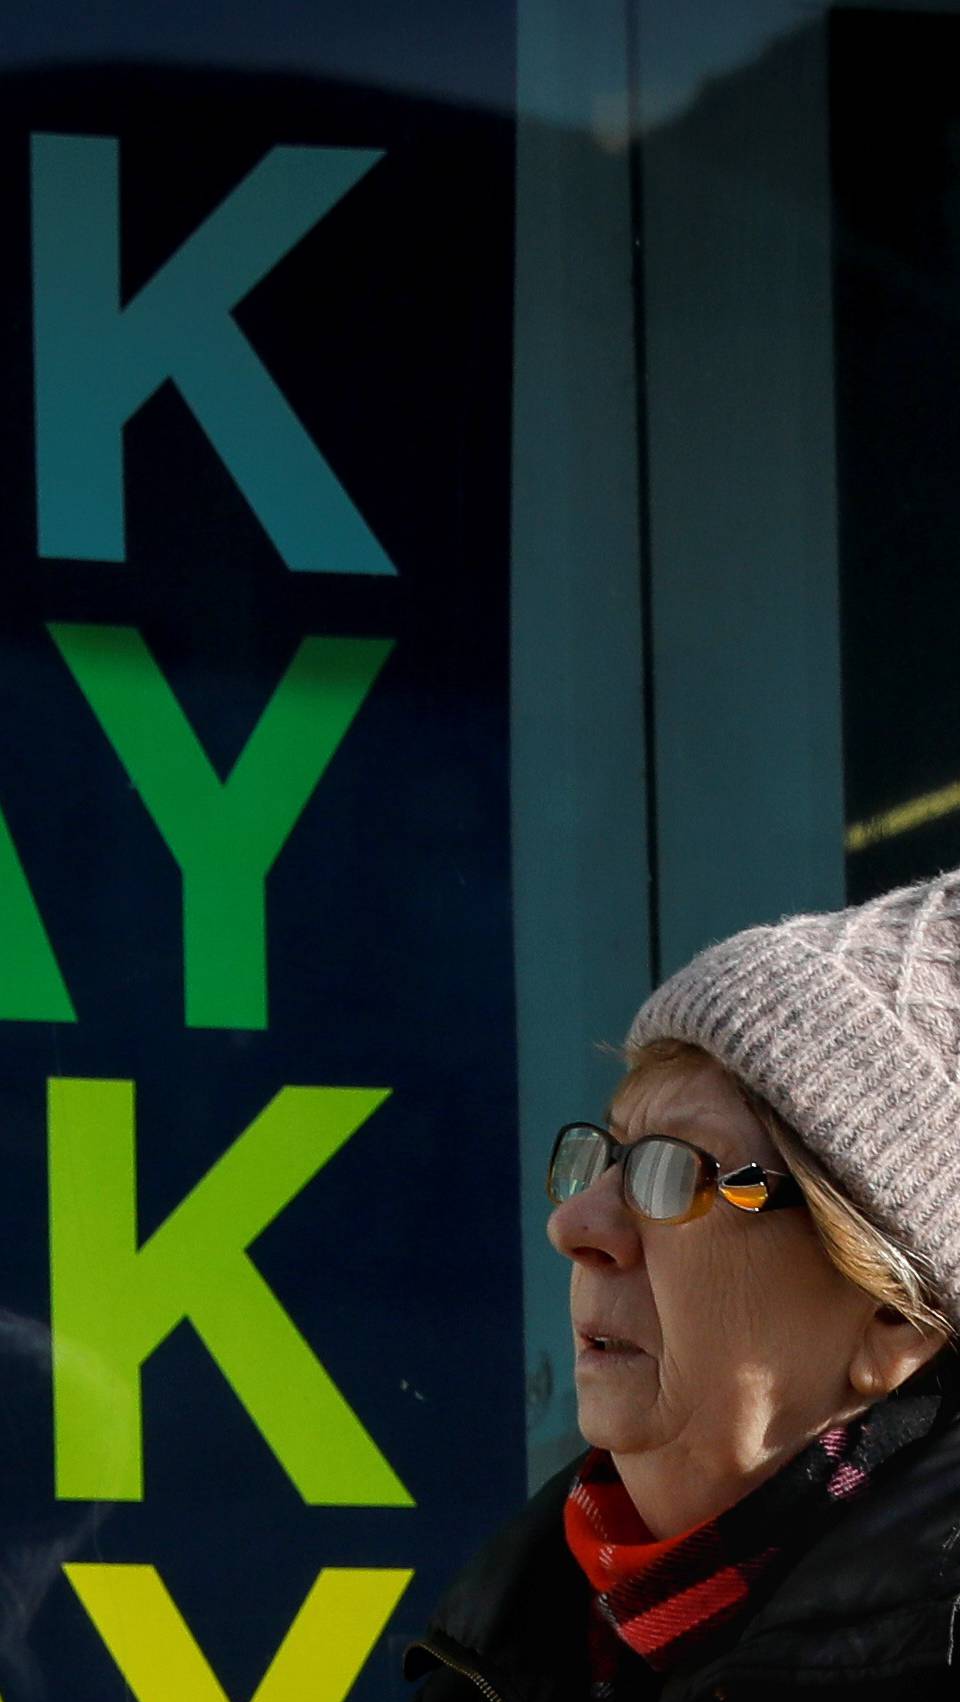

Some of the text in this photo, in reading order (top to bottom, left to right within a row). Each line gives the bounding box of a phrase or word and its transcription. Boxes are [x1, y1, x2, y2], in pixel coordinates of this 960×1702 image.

[28, 130, 399, 577] K
[0, 620, 398, 1030] Y
[46, 1076, 417, 1508] K
